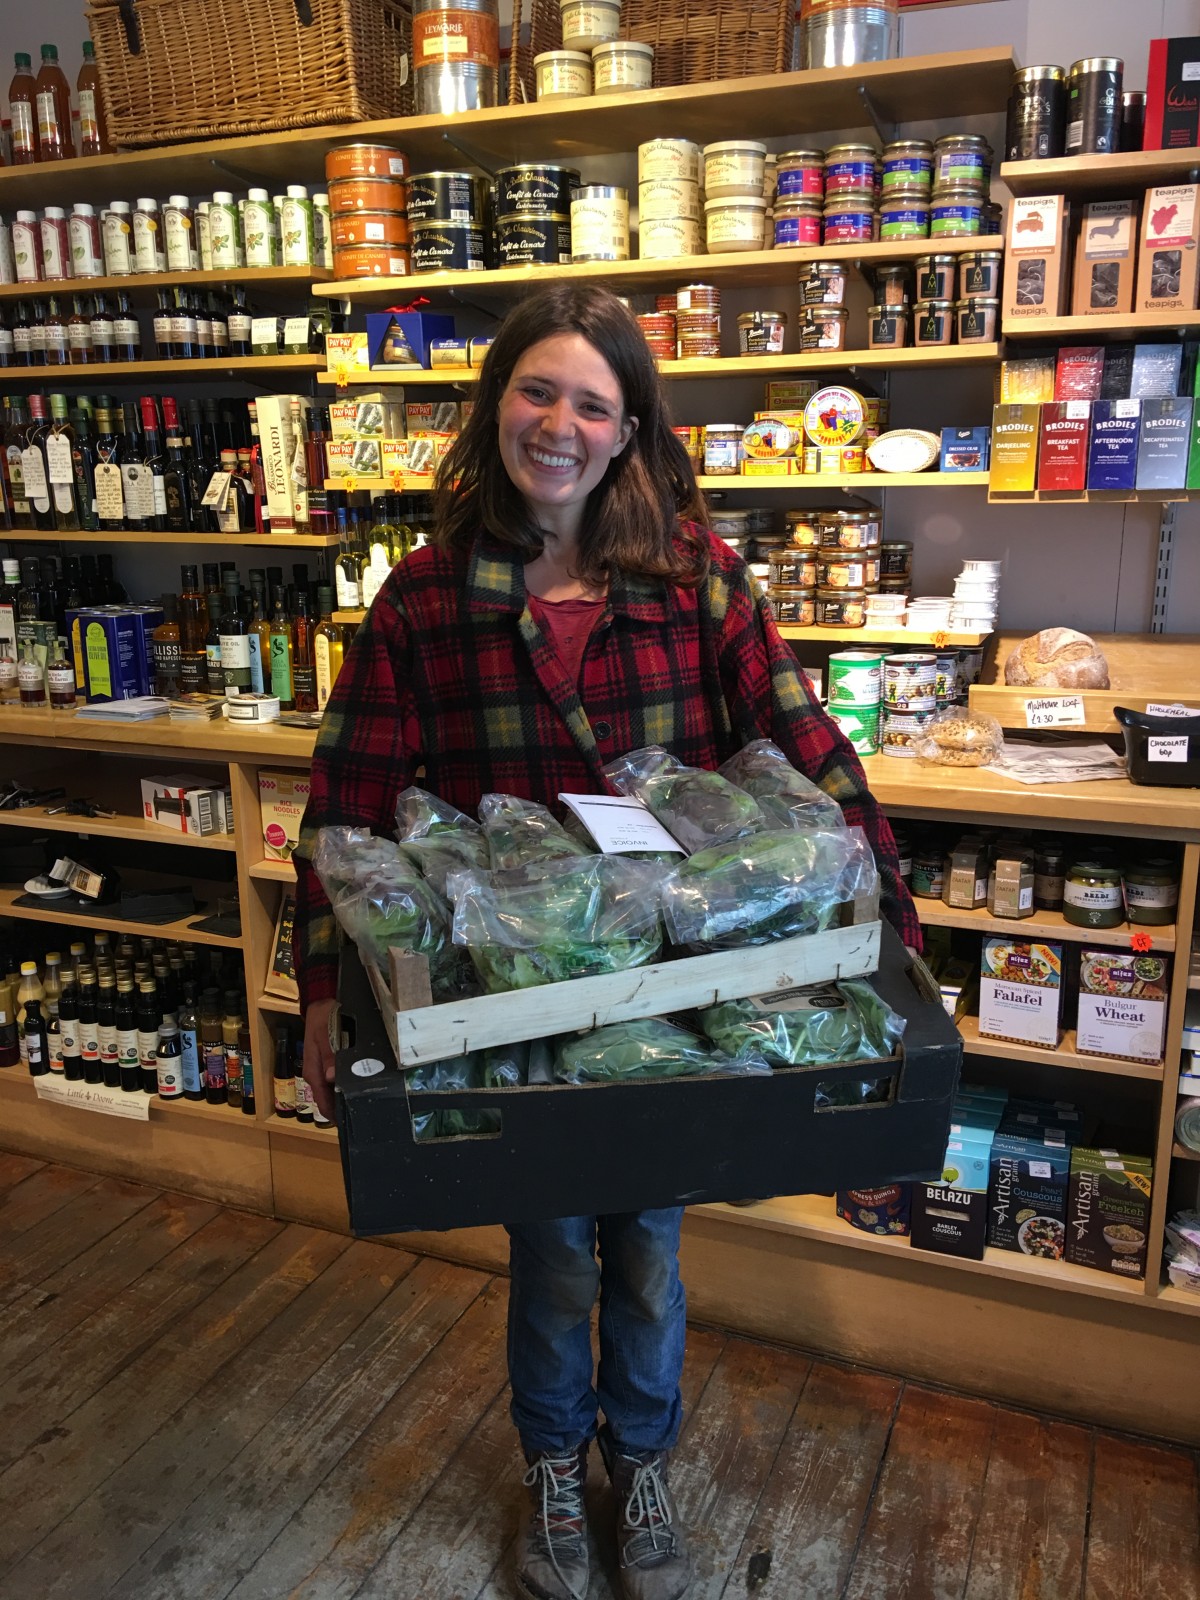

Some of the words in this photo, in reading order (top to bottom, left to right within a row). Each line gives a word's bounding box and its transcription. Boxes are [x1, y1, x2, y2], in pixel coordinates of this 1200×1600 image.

[424, 23, 464, 35] LEYMARIE
[532, 189, 558, 199] Canard
[520, 240, 545, 249] Canard
[429, 247, 454, 257] Canard
[329, 338, 339, 347] PAY
[340, 337, 351, 347] PAY
[1064, 355, 1098, 364] BRODIES
[333, 409, 343, 417] PAY
[344, 408, 356, 417] PAY
[408, 406, 419, 415] PAY
[420, 405, 431, 415] PAY
[995, 423, 1035, 434] BRODIES
[1045, 421, 1085, 432] BRODIES
[1095, 420, 1136, 431] BRODIES
[1145, 418, 1187, 429] BRODIES
[330, 446, 341, 454] PAY
[341, 445, 353, 454] PAY
[384, 444, 395, 453] PAY
[395, 444, 407, 453] PAY
[995, 442, 1031, 450] DARJEELING
[270, 426, 286, 495] LEONARDI
[1150, 739, 1187, 747] CHOCOLATE
[1159, 748, 1172, 757] 60p
[273, 806, 301, 815] NOODLES
[1137, 938, 1147, 948] GF
[1041, 949, 1058, 966] NEW!
[995, 982, 1021, 992] Moroccan
[1023, 986, 1042, 995] Spiced
[993, 988, 1043, 1006] Falafel
[1104, 999, 1137, 1011] Bulgur
[1094, 1006, 1146, 1023] Wheat
[67, 1088, 84, 1099] Little
[92, 1093, 114, 1105] Doone
[996, 1143, 1026, 1153] Artisan
[1092, 1173, 1101, 1197] grains
[1133, 1175, 1150, 1191] NEW!
[873, 1189, 896, 1200] QUINOA
[993, 1158, 1012, 1220] Artisan
[1040, 1185, 1063, 1195] Pearl
[926, 1187, 971, 1205] BELAZU
[1013, 1187, 1063, 1203] Couscous
[1072, 1170, 1093, 1234] Artisan
[1103, 1195, 1145, 1208] Greenwheat
[1098, 1201, 1144, 1217] Freekeh
[932, 1226, 962, 1236] COUSCOUS
[937, 1222, 958, 1231] BARLEY
